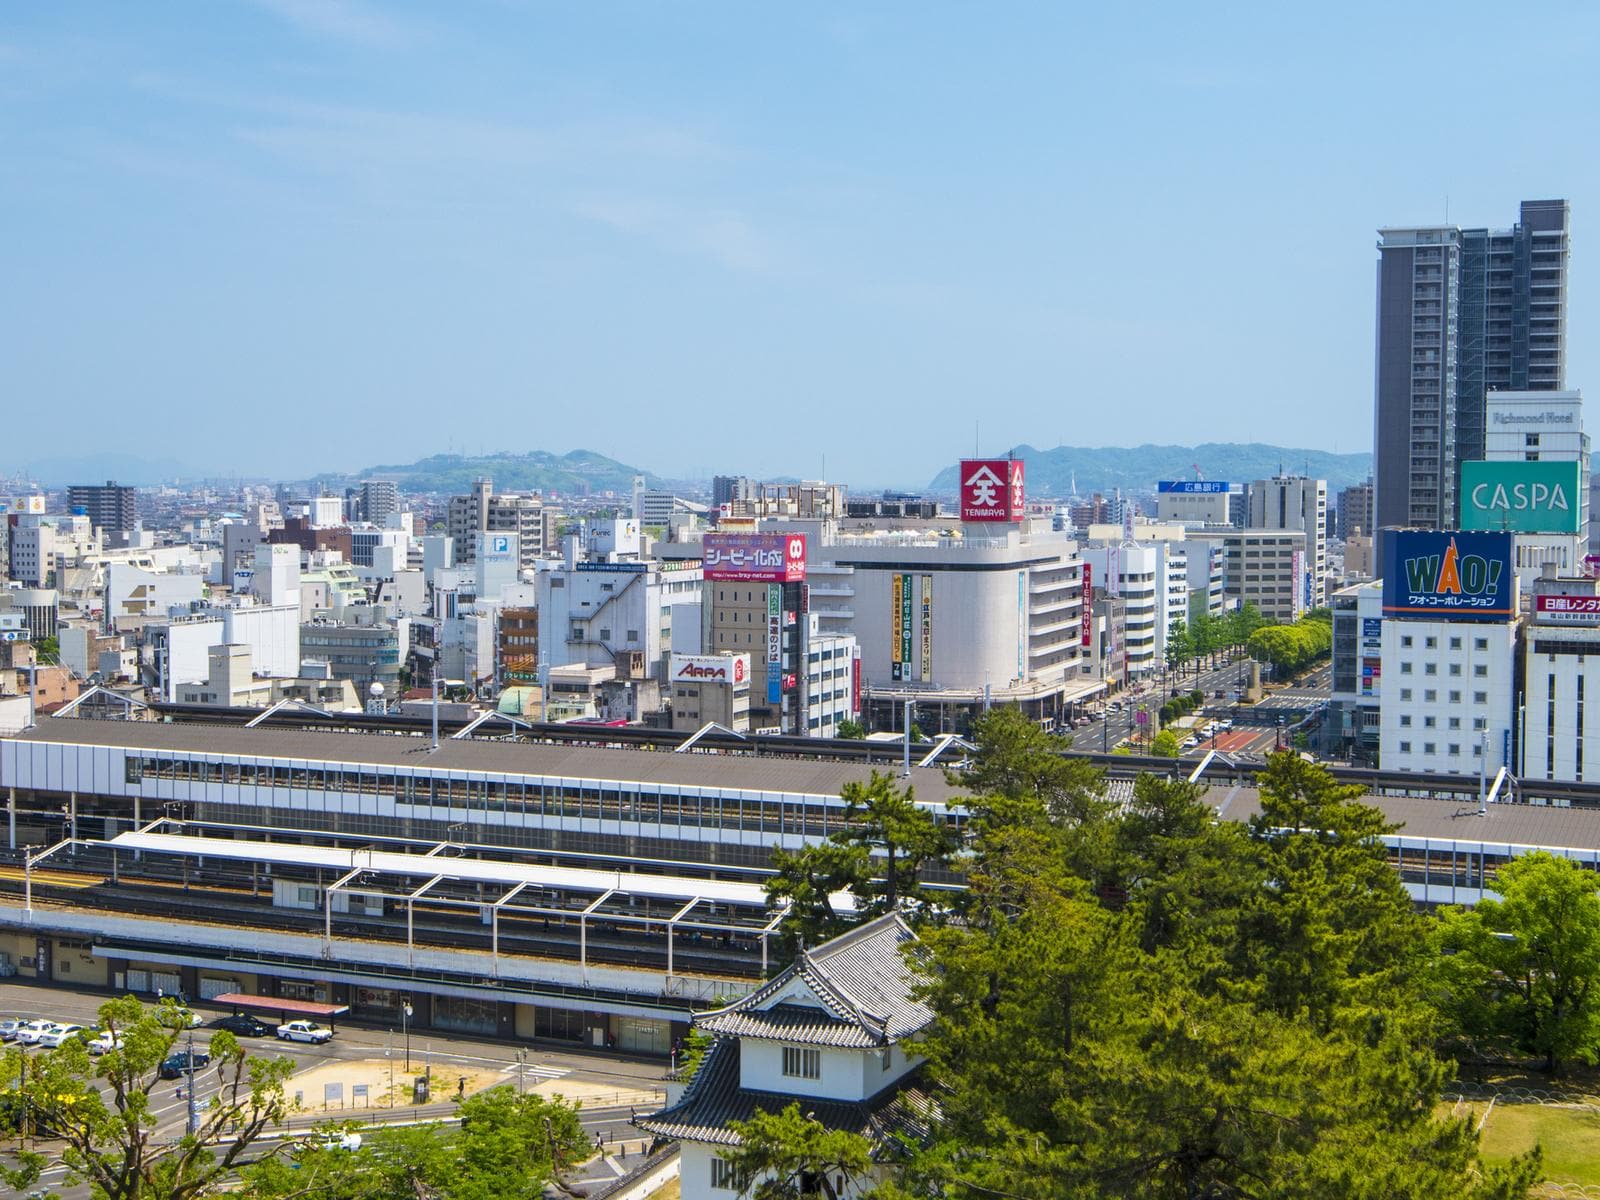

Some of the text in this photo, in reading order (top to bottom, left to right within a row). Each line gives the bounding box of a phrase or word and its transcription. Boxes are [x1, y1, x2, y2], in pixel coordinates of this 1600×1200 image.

[1493, 411, 1573, 424] Richmond Hotel
[1184, 482, 1221, 492] 広島銀行
[1471, 483, 1569, 510] CASPA
[964, 508, 1005, 517] TENMAYA
[495, 538, 507, 551] P
[1405, 536, 1503, 596] WAO!
[1083, 581, 1091, 636] TENMAYA
[678, 662, 726, 678] ARPA
